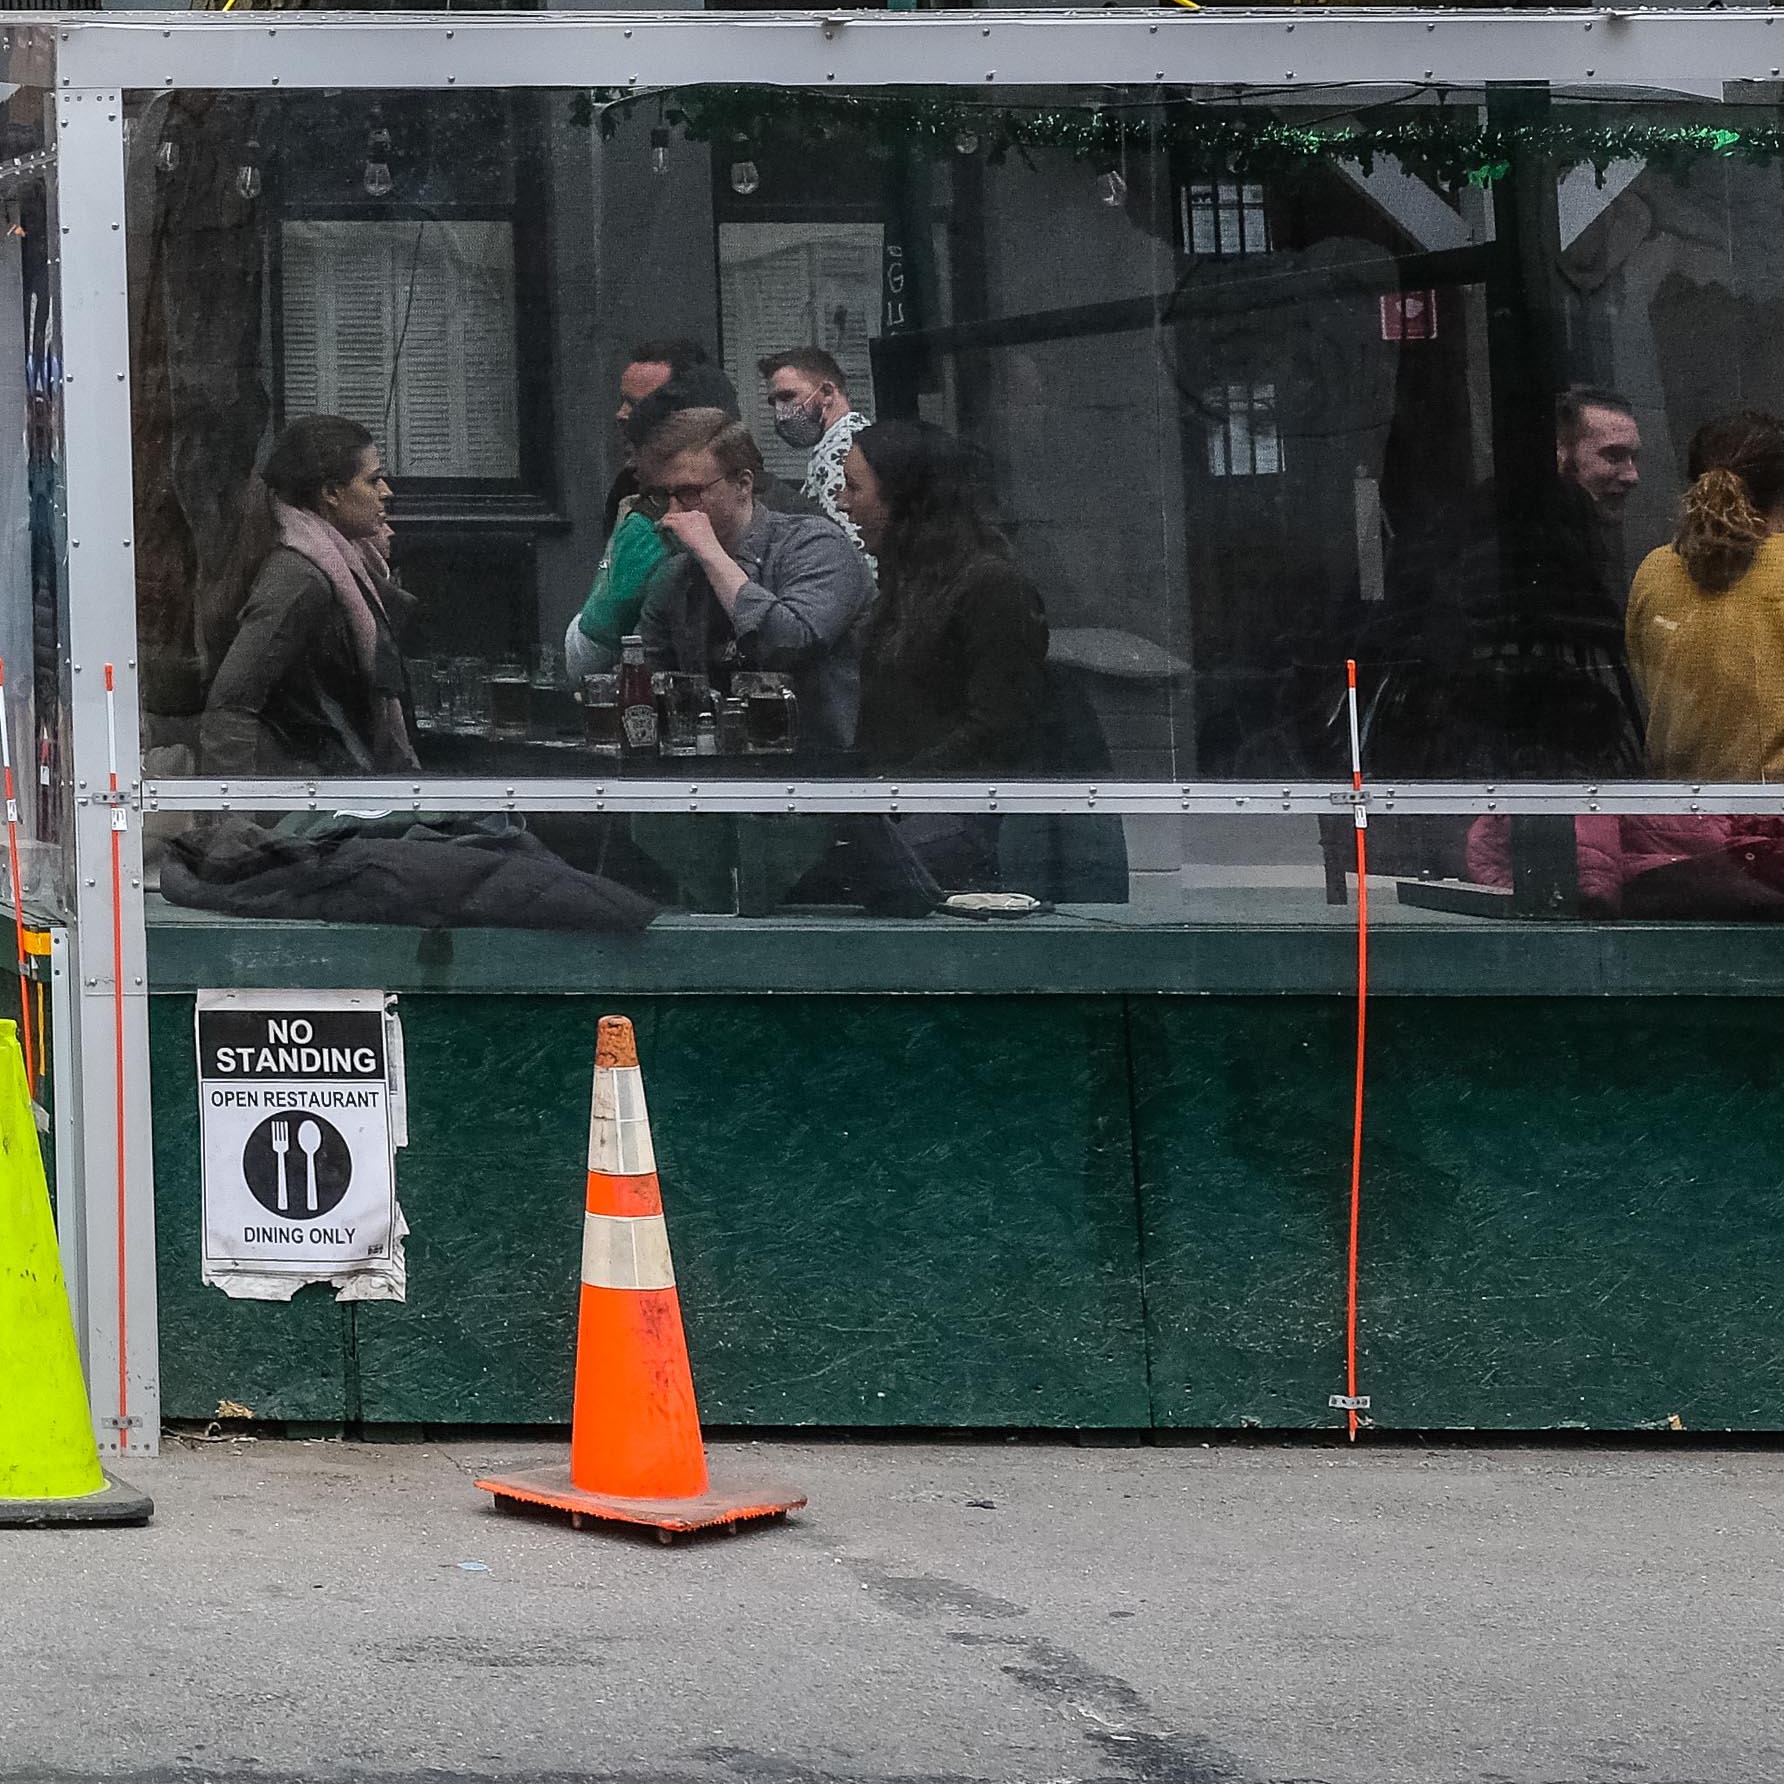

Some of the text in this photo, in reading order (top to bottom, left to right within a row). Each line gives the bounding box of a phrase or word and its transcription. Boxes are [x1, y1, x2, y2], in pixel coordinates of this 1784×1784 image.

[268, 1019, 314, 1045] NO
[216, 1045, 377, 1074] STANDING
[210, 1090, 379, 1108] OPEN RESTAURANT
[244, 1226, 355, 1245] DINING ONLY
